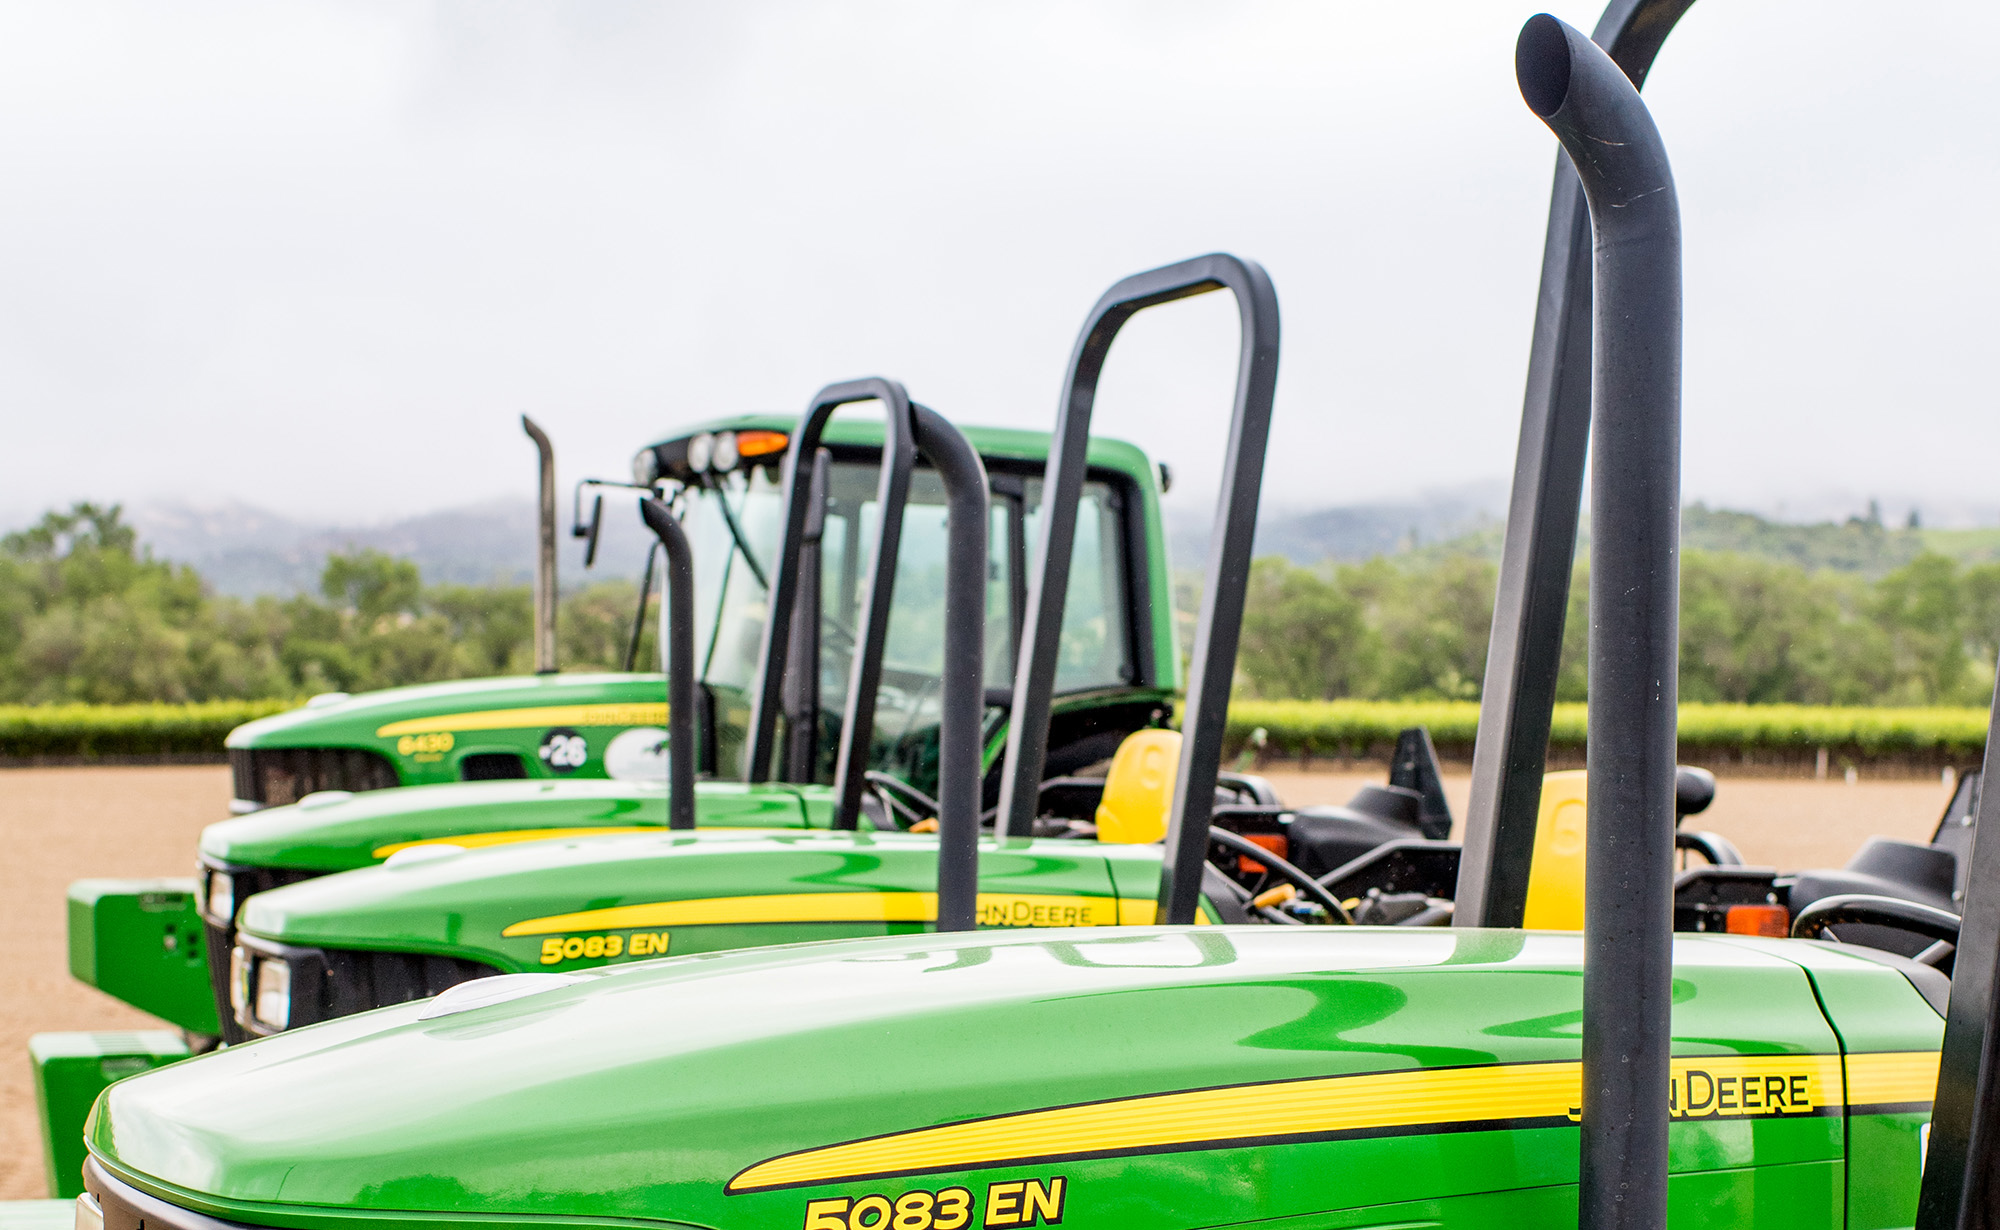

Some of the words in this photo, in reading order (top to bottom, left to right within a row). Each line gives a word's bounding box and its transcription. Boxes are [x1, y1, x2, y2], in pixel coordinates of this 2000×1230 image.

[1013, 901, 1092, 923] DEERE
[540, 934, 624, 965] 5083
[628, 932, 669, 956] EN
[1686, 1069, 1809, 1110] DEERE
[803, 1187, 972, 1230] 5083
[984, 1177, 1064, 1227] EN
